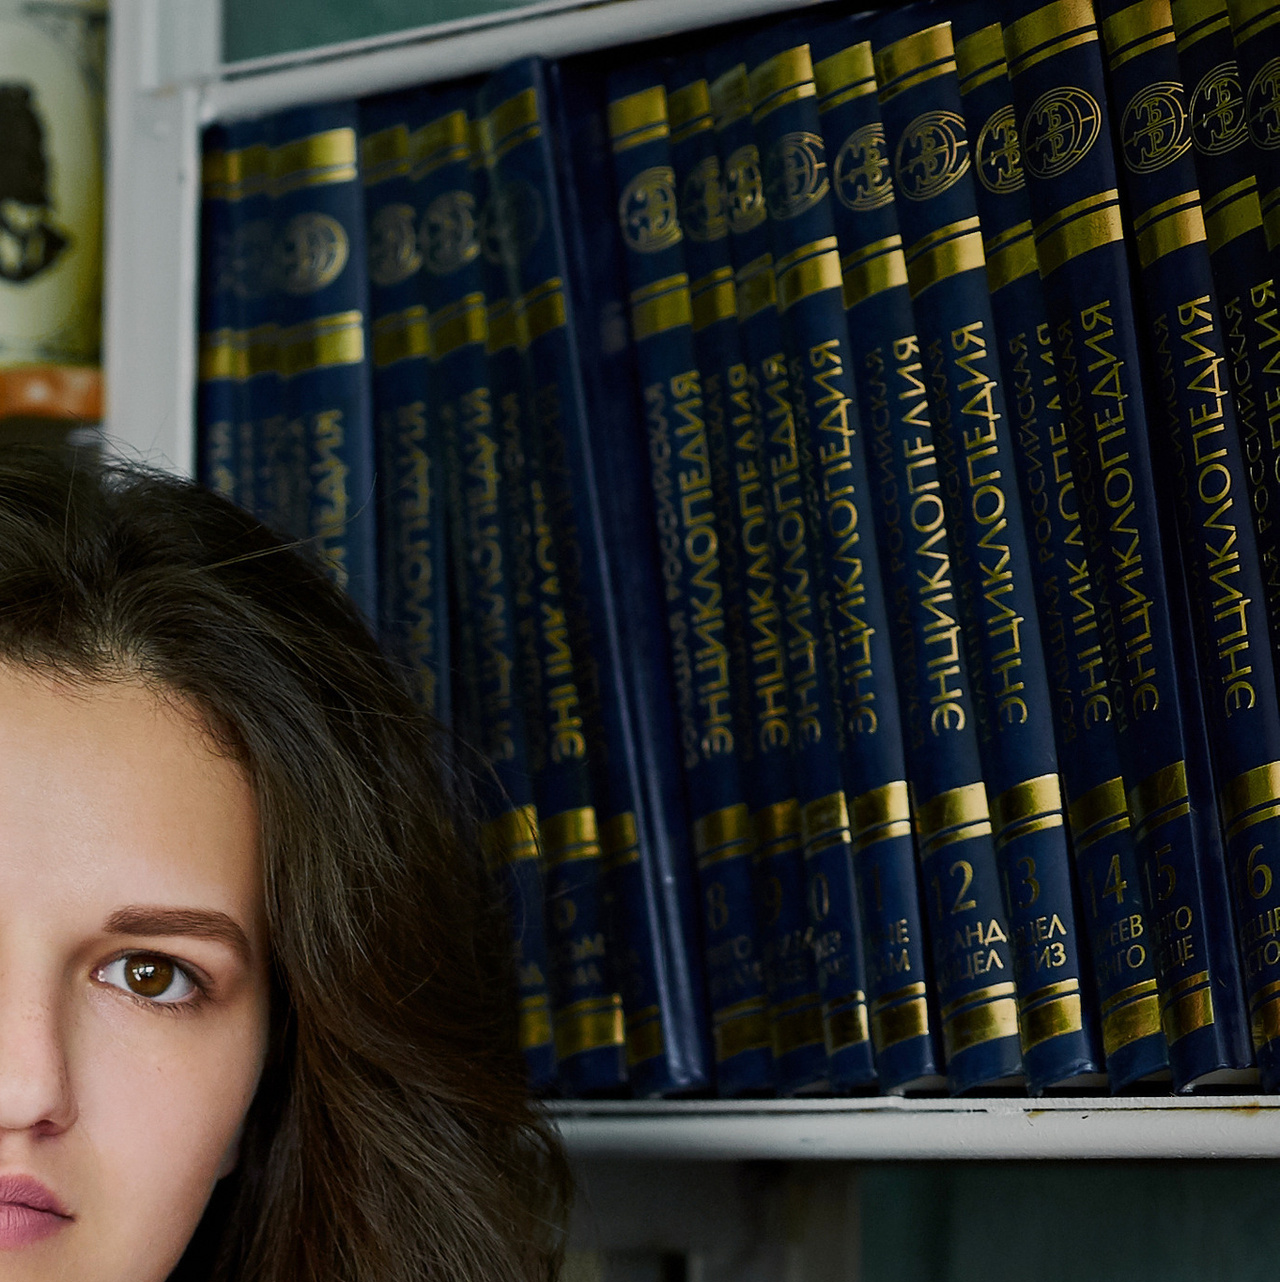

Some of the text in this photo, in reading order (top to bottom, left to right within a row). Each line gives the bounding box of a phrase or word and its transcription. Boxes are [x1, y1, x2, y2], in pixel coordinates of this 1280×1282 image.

[951, 320, 1028, 732] ЭНЦИКЛОПЕДИЯ
[1008, 331, 1056, 561] РОССИЙСКАЯ
[1081, 299, 1160, 721] ЭНЦИКЛОПЕДИЯ
[1178, 295, 1257, 718] ЭНЦИКЛОПЕДИЯ
[1224, 295, 1273, 534] РОССИЙСКАЯ
[810, 338, 878, 741] ЭНЦИКЛОПЕДИЯ
[931, 860, 977, 921] 12
[1086, 853, 1128, 919] 14
[1143, 842, 1177, 911] 15
[1232, 842, 1274, 911] 16
